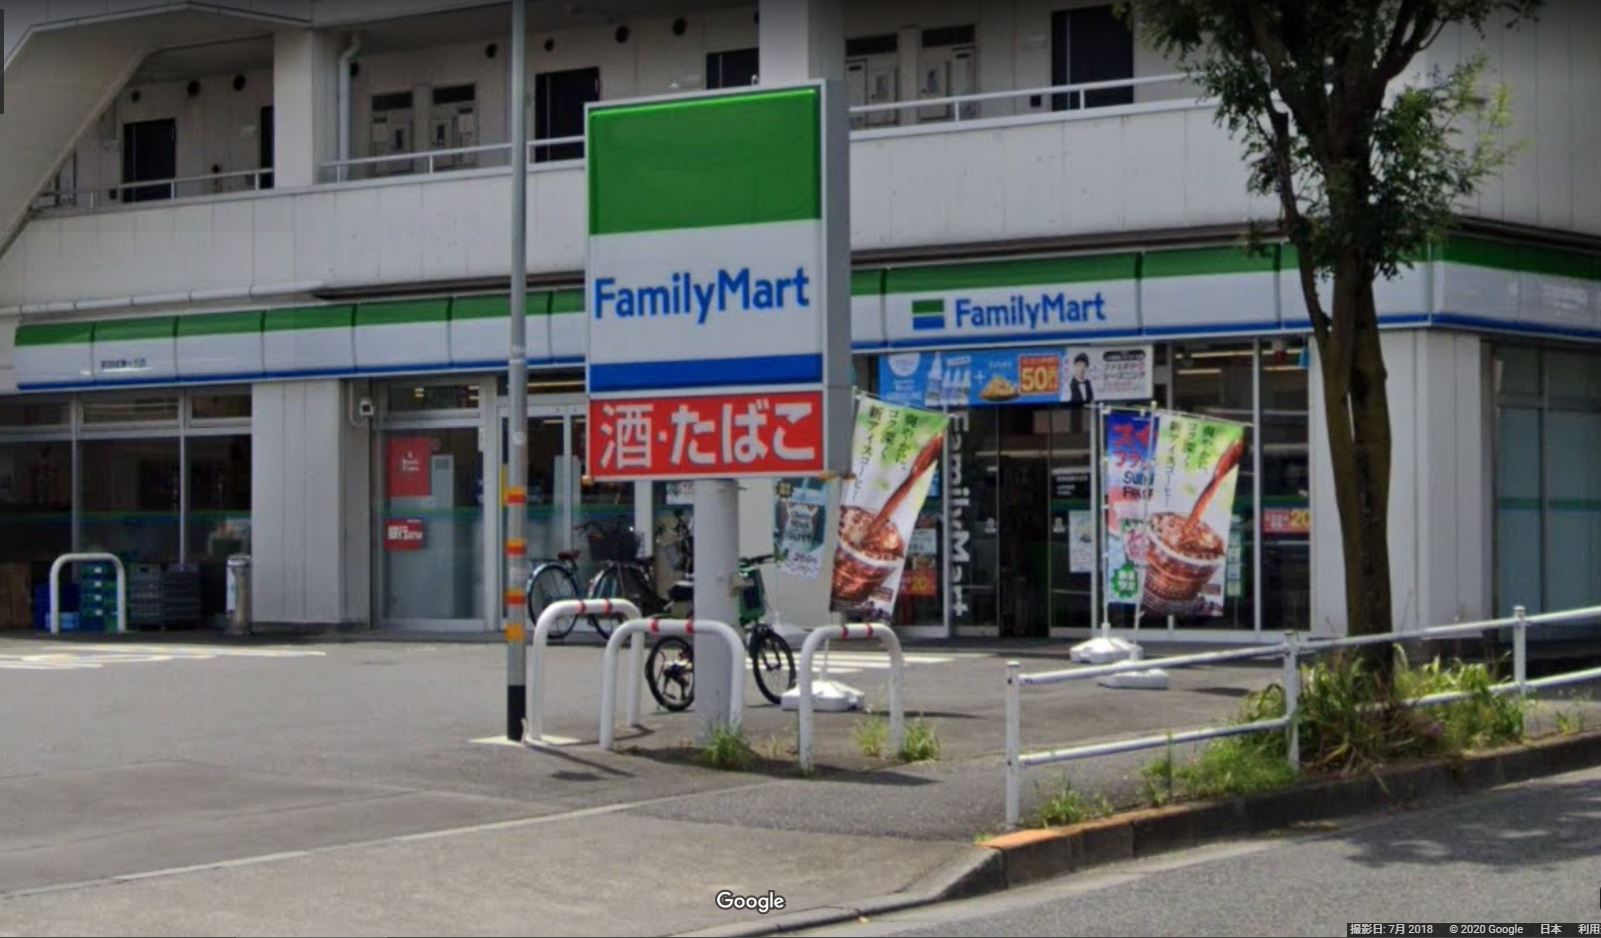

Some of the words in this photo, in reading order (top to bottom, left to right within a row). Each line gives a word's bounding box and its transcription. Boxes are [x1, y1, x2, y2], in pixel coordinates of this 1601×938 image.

[594, 267, 810, 324] FamilyMart
[955, 292, 1106, 329] FamilyMart
[600, 399, 816, 469] 酒・たばこ
